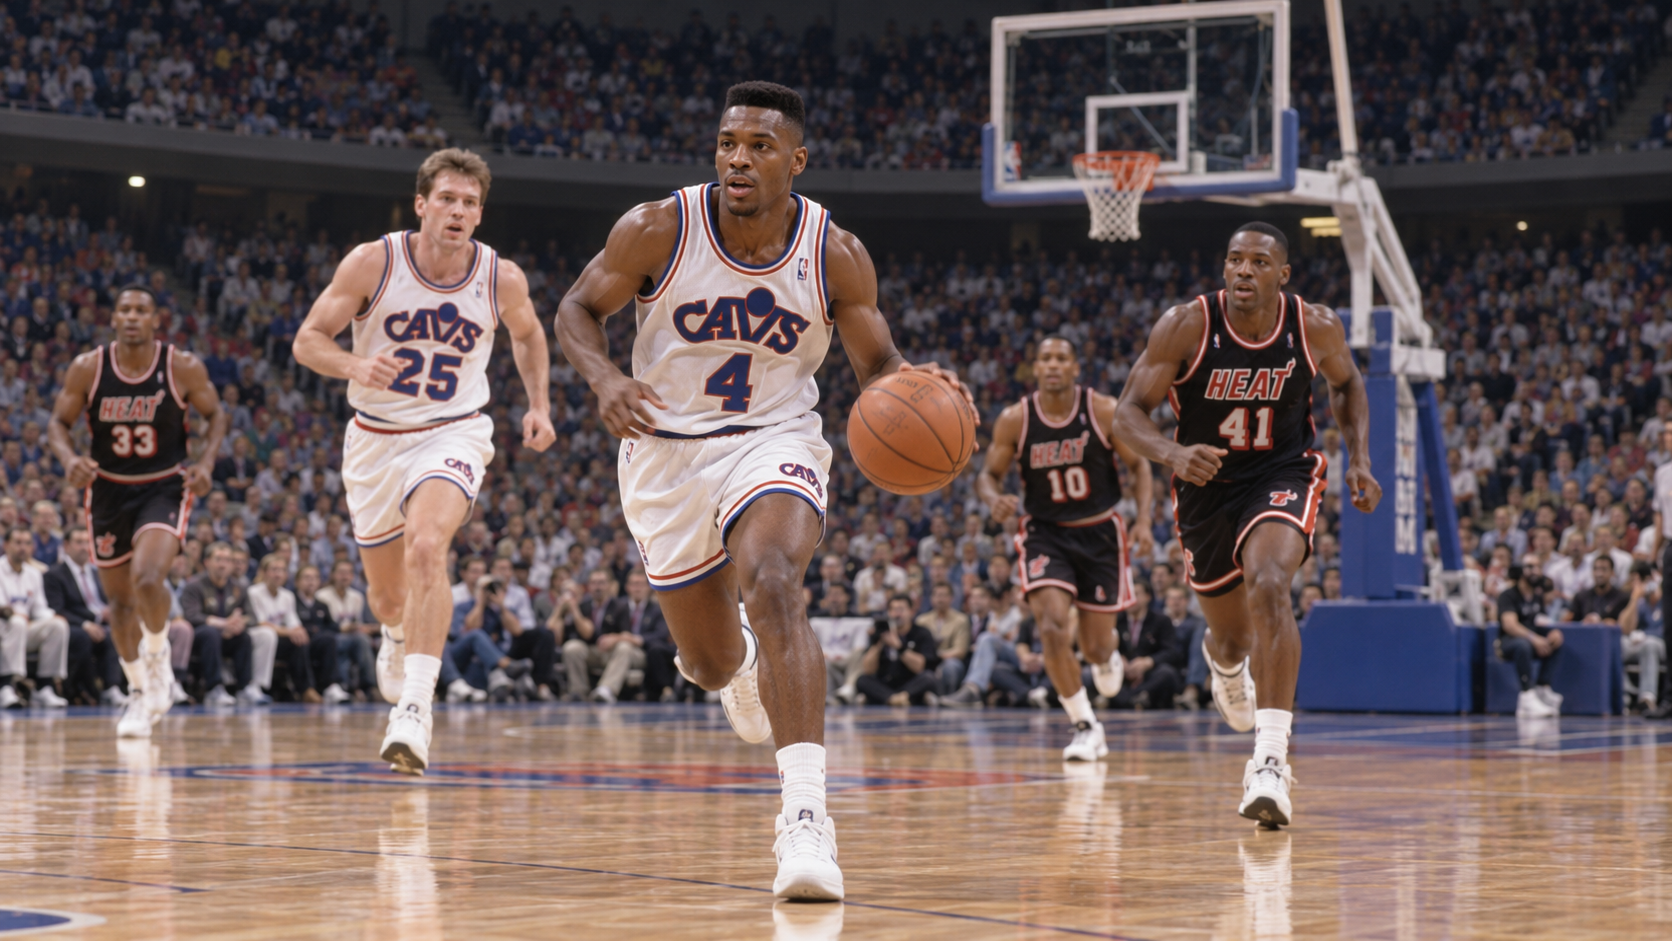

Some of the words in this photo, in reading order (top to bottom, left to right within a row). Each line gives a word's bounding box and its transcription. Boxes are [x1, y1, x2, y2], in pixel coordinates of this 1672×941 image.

[383, 302, 484, 353] CAVS
[673, 286, 811, 355] CAVS
[387, 347, 463, 402] 25
[704, 352, 753, 414] 4
[1204, 357, 1297, 401] HEAT
[99, 389, 166, 422] HEAT
[111, 424, 158, 459] 33
[1030, 430, 1090, 469] HEAT
[1219, 406, 1274, 451] 41
[1047, 466, 1091, 503] 10
